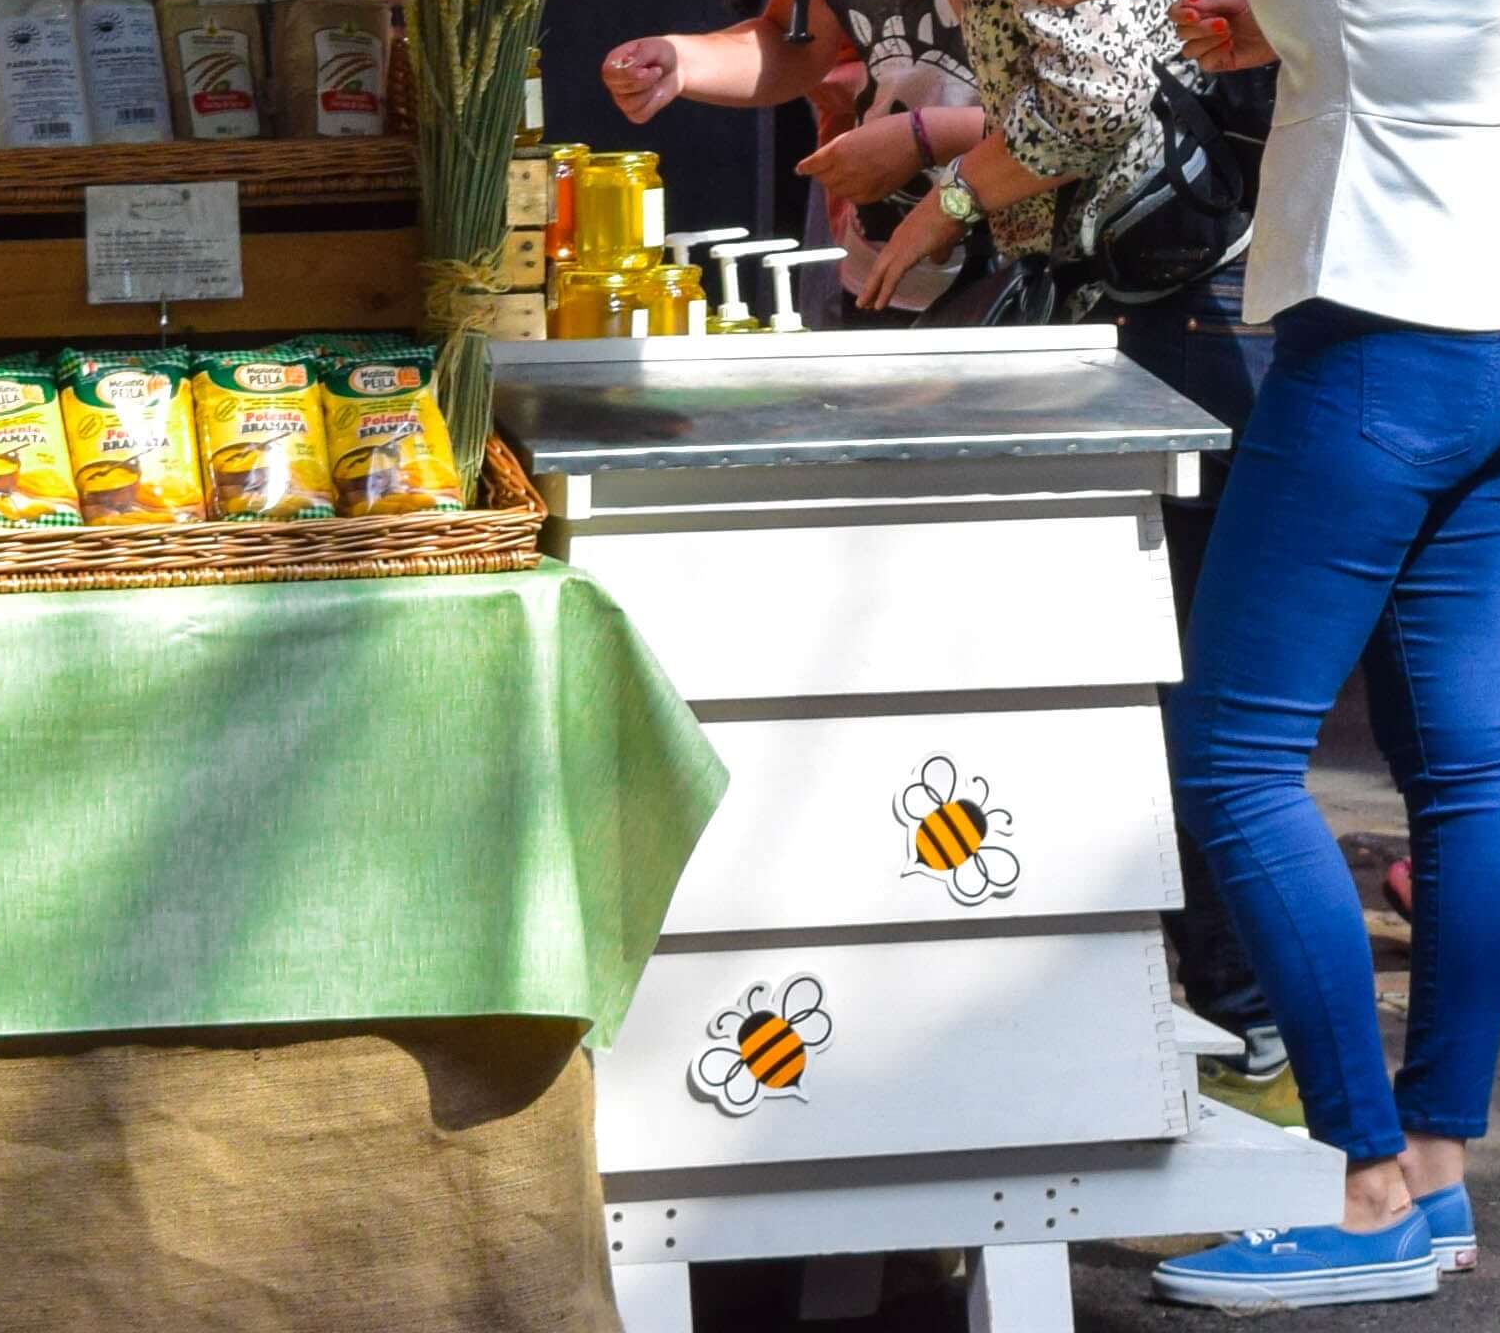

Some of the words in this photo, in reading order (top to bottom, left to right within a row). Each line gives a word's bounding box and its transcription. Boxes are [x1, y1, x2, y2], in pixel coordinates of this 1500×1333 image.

[243, 410, 301, 422] Polenta
[362, 413, 418, 426] Polenta
[241, 421, 308, 434] BRAMATA
[358, 424, 425, 438] BRAMATA
